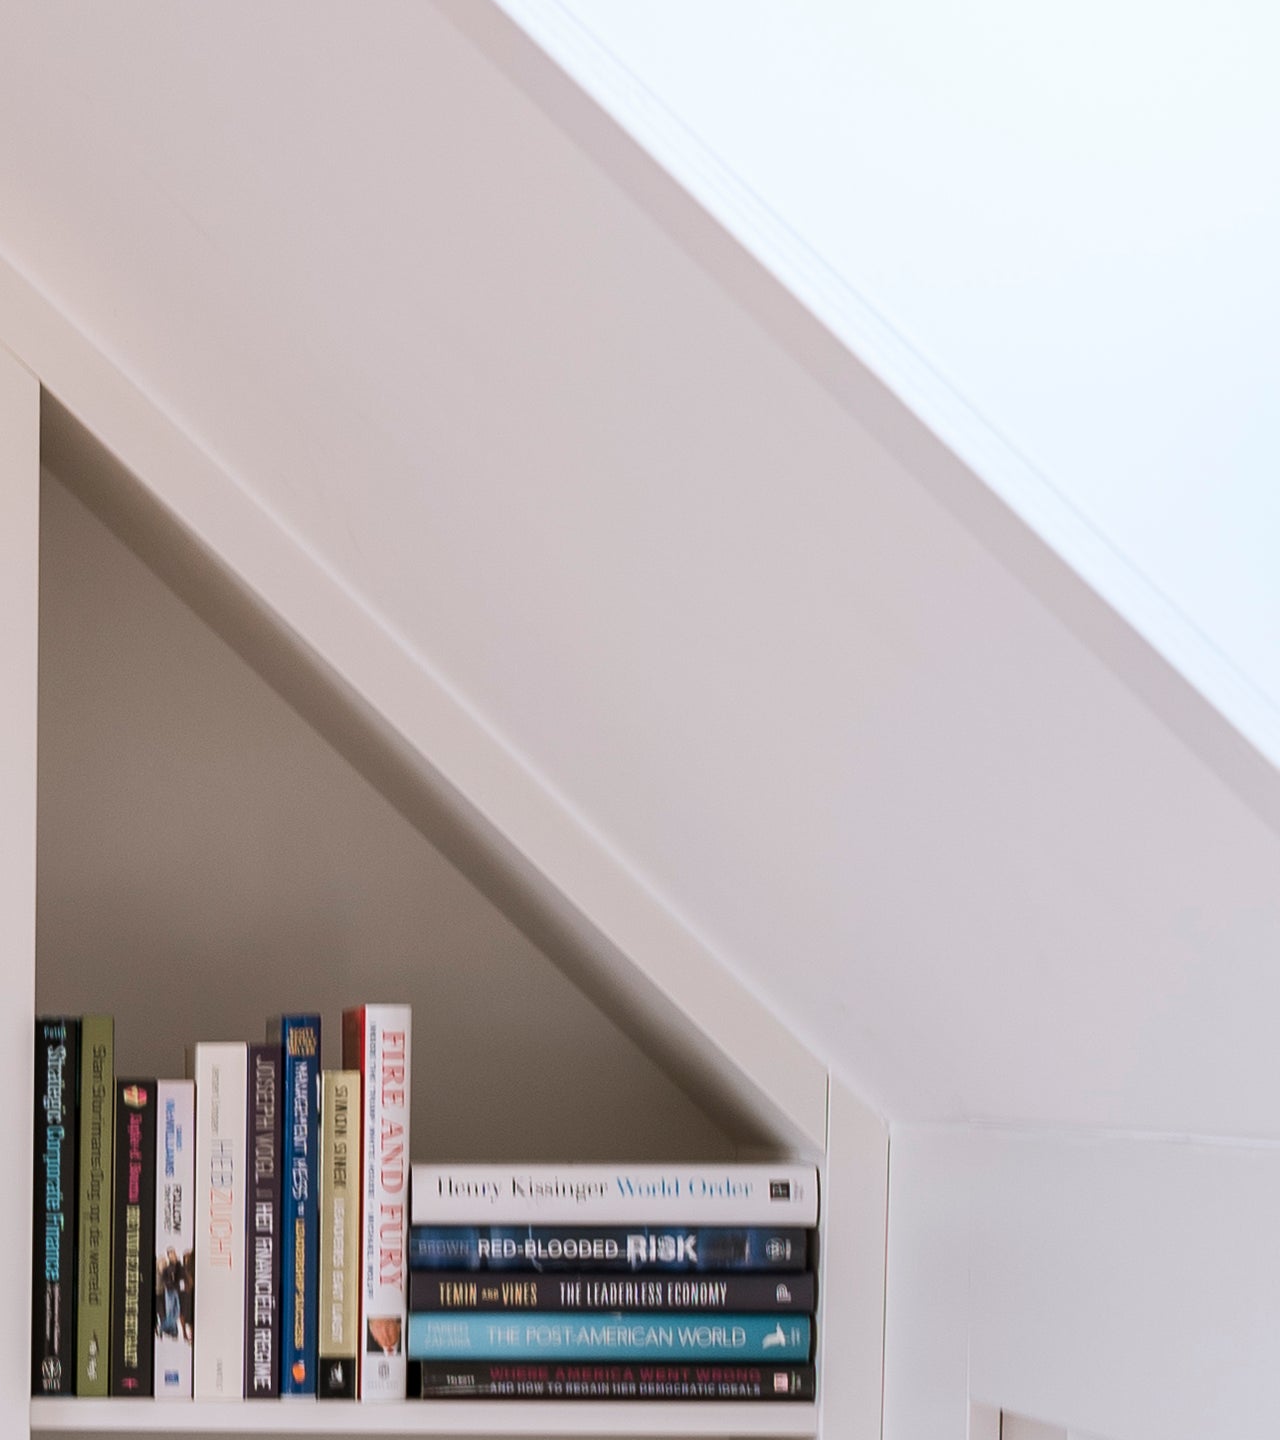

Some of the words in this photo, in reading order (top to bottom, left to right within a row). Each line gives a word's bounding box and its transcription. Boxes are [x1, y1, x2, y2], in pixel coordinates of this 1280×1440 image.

[44, 1045, 68, 1124] Strategic
[380, 1029, 406, 1110] FIRE
[43, 1125, 66, 1211] Corporate
[380, 1116, 405, 1194] AND
[437, 1176, 502, 1204] Henry
[512, 1176, 608, 1203] Kissinger
[617, 1176, 680, 1197] World
[689, 1176, 753, 1198] Order
[44, 1213, 66, 1283] Finance
[380, 1202, 405, 1293] FURY
[418, 1241, 469, 1255] BROWN
[477, 1238, 618, 1259] RED-BLOODED
[626, 1234, 698, 1262] RISK
[439, 1282, 477, 1307] TEMIN
[502, 1282, 537, 1307] VINES
[560, 1282, 583, 1306] THE
[587, 1282, 662, 1306] LEADERLESS
[668, 1282, 727, 1306] ECONOMY
[487, 1325, 520, 1345] THE
[525, 1325, 674, 1347] POST-AMERICAN
[678, 1327, 746, 1347] WORLD
[490, 1367, 548, 1382] WHERE
[555, 1367, 633, 1382] AMERICA
[641, 1367, 689, 1382] WENT
[695, 1367, 761, 1382] WRONG
[490, 1381, 516, 1394] AND
[519, 1381, 543, 1394] HOW
[548, 1381, 562, 1394] TO
[566, 1381, 609, 1395] REGAIN
[613, 1382, 636, 1395] HER
[640, 1382, 715, 1395] DEMOCRATIC
[718, 1382, 761, 1396] IDEALS
